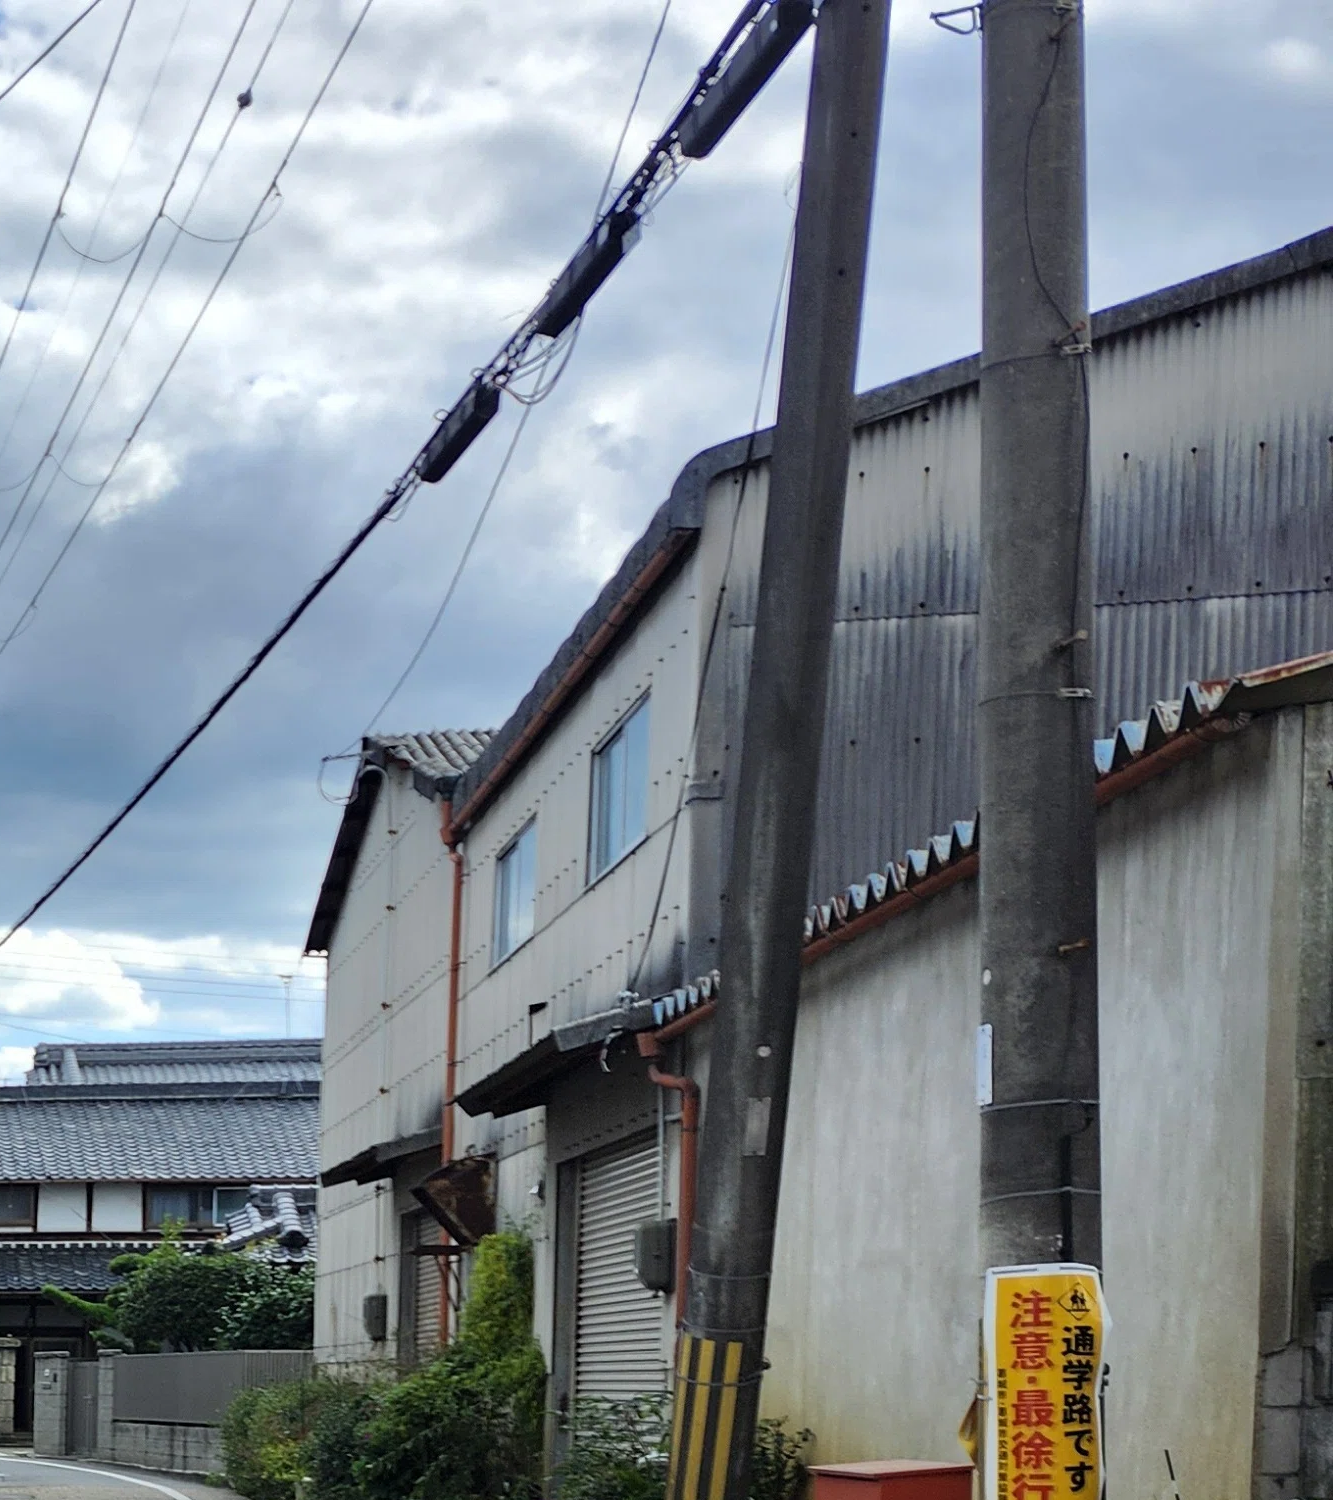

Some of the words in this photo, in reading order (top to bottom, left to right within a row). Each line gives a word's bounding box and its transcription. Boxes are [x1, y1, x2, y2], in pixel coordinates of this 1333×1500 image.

[1061, 1324, 1095, 1492] 通学路です
